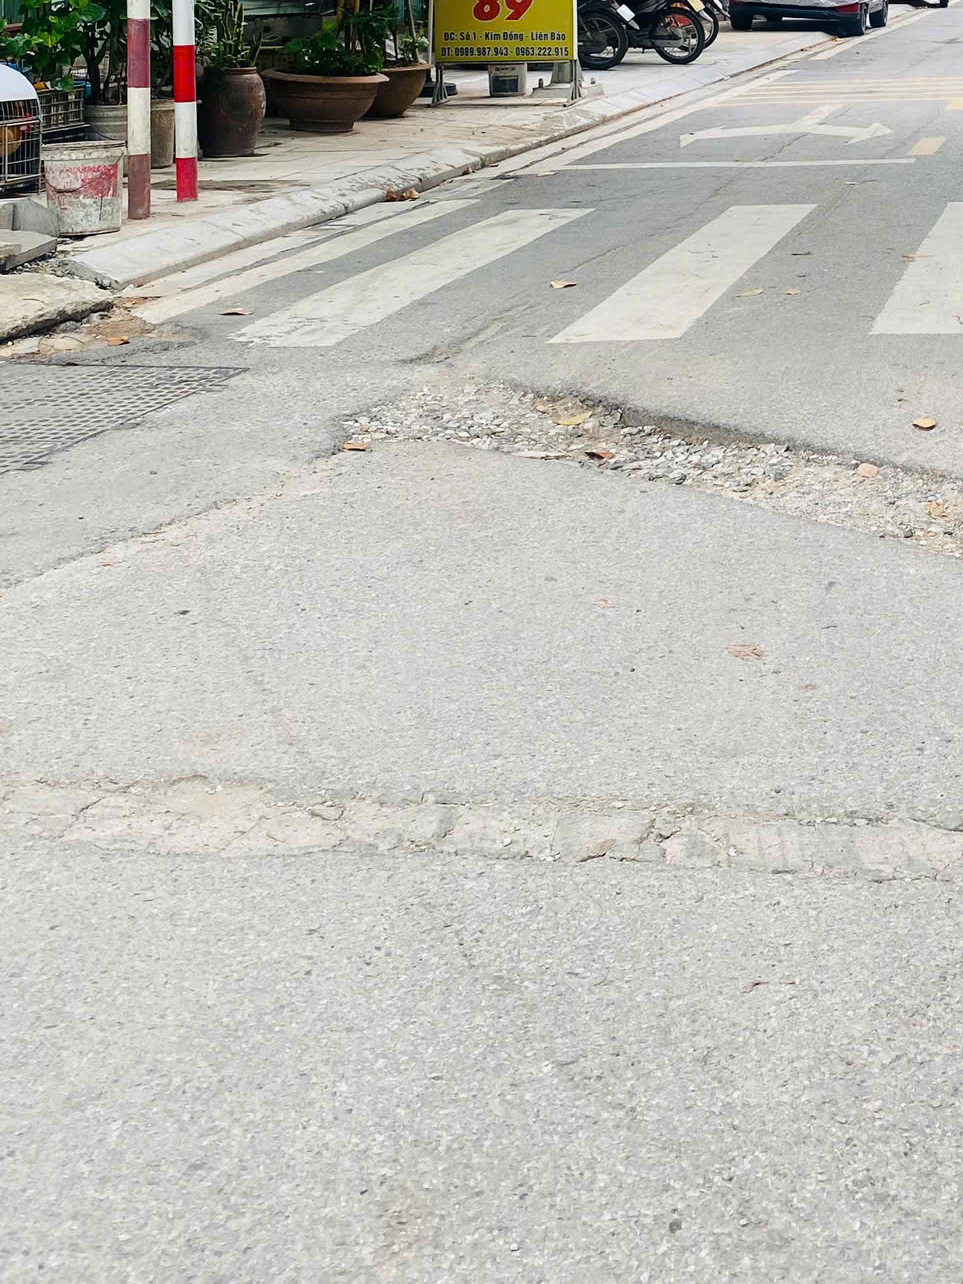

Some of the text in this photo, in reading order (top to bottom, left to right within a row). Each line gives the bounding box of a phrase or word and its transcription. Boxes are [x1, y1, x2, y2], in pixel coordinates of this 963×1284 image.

[472, 31, 477, 41] 1
[485, 31, 500, 41] Kim
[531, 31, 548, 41] Liên
[515, 46, 569, 57] 0963.222.915
